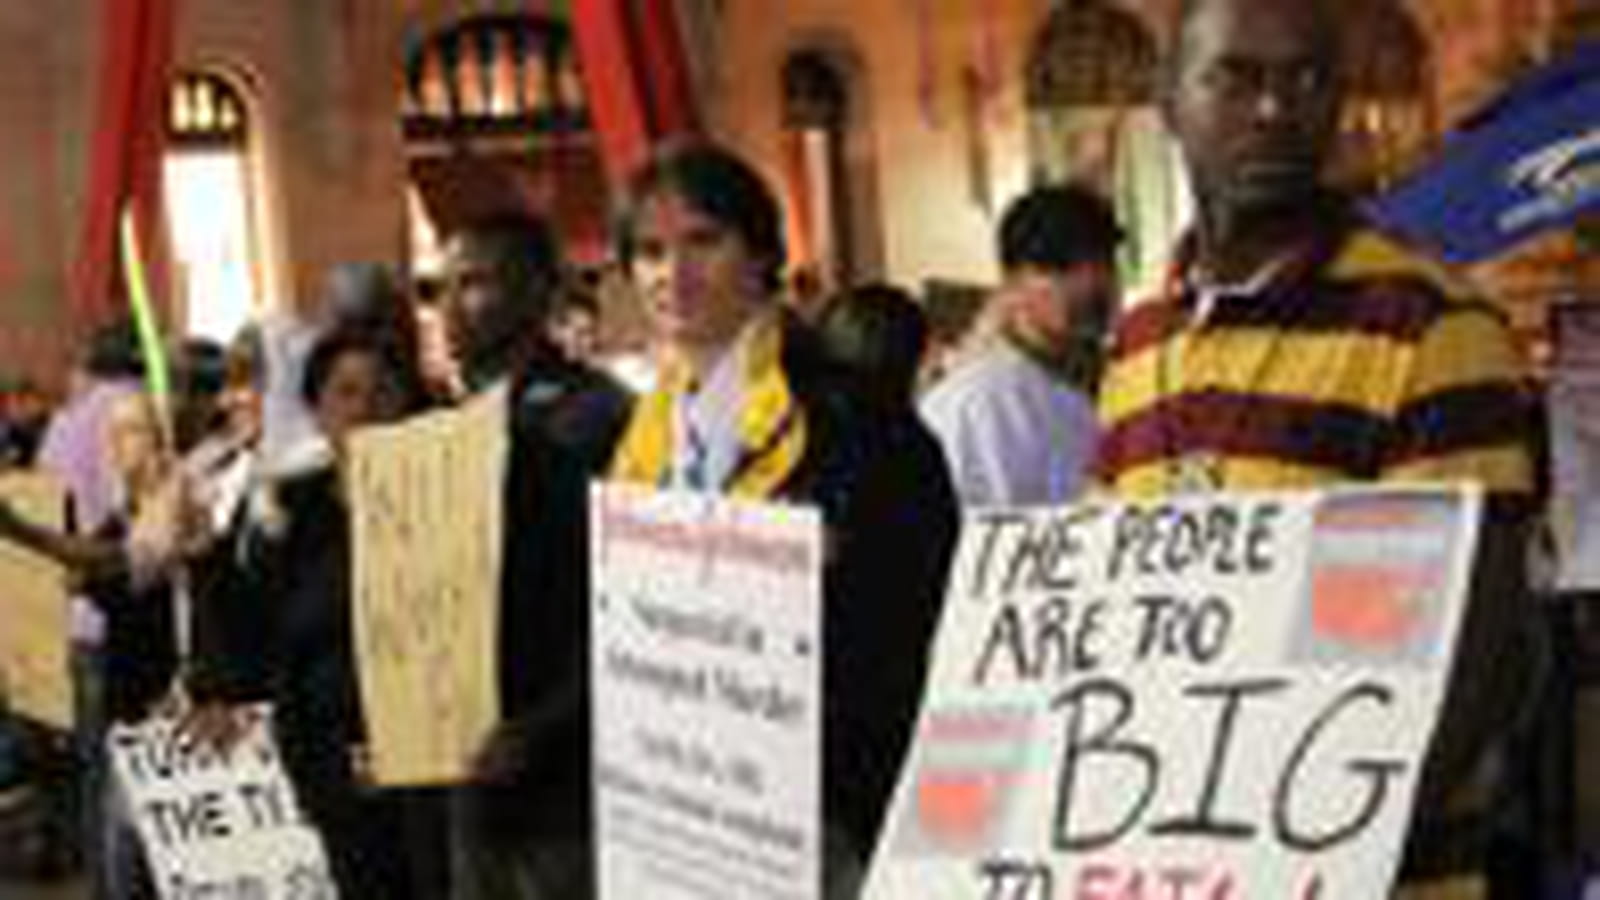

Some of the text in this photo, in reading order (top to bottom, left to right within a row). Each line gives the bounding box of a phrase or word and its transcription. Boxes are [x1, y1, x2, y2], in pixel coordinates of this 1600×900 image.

[970, 503, 1281, 597] THE PEOPLE
[973, 596, 1233, 685] ARE TOO
[1050, 678, 1407, 852] BIG
[146, 787, 231, 847] THE
